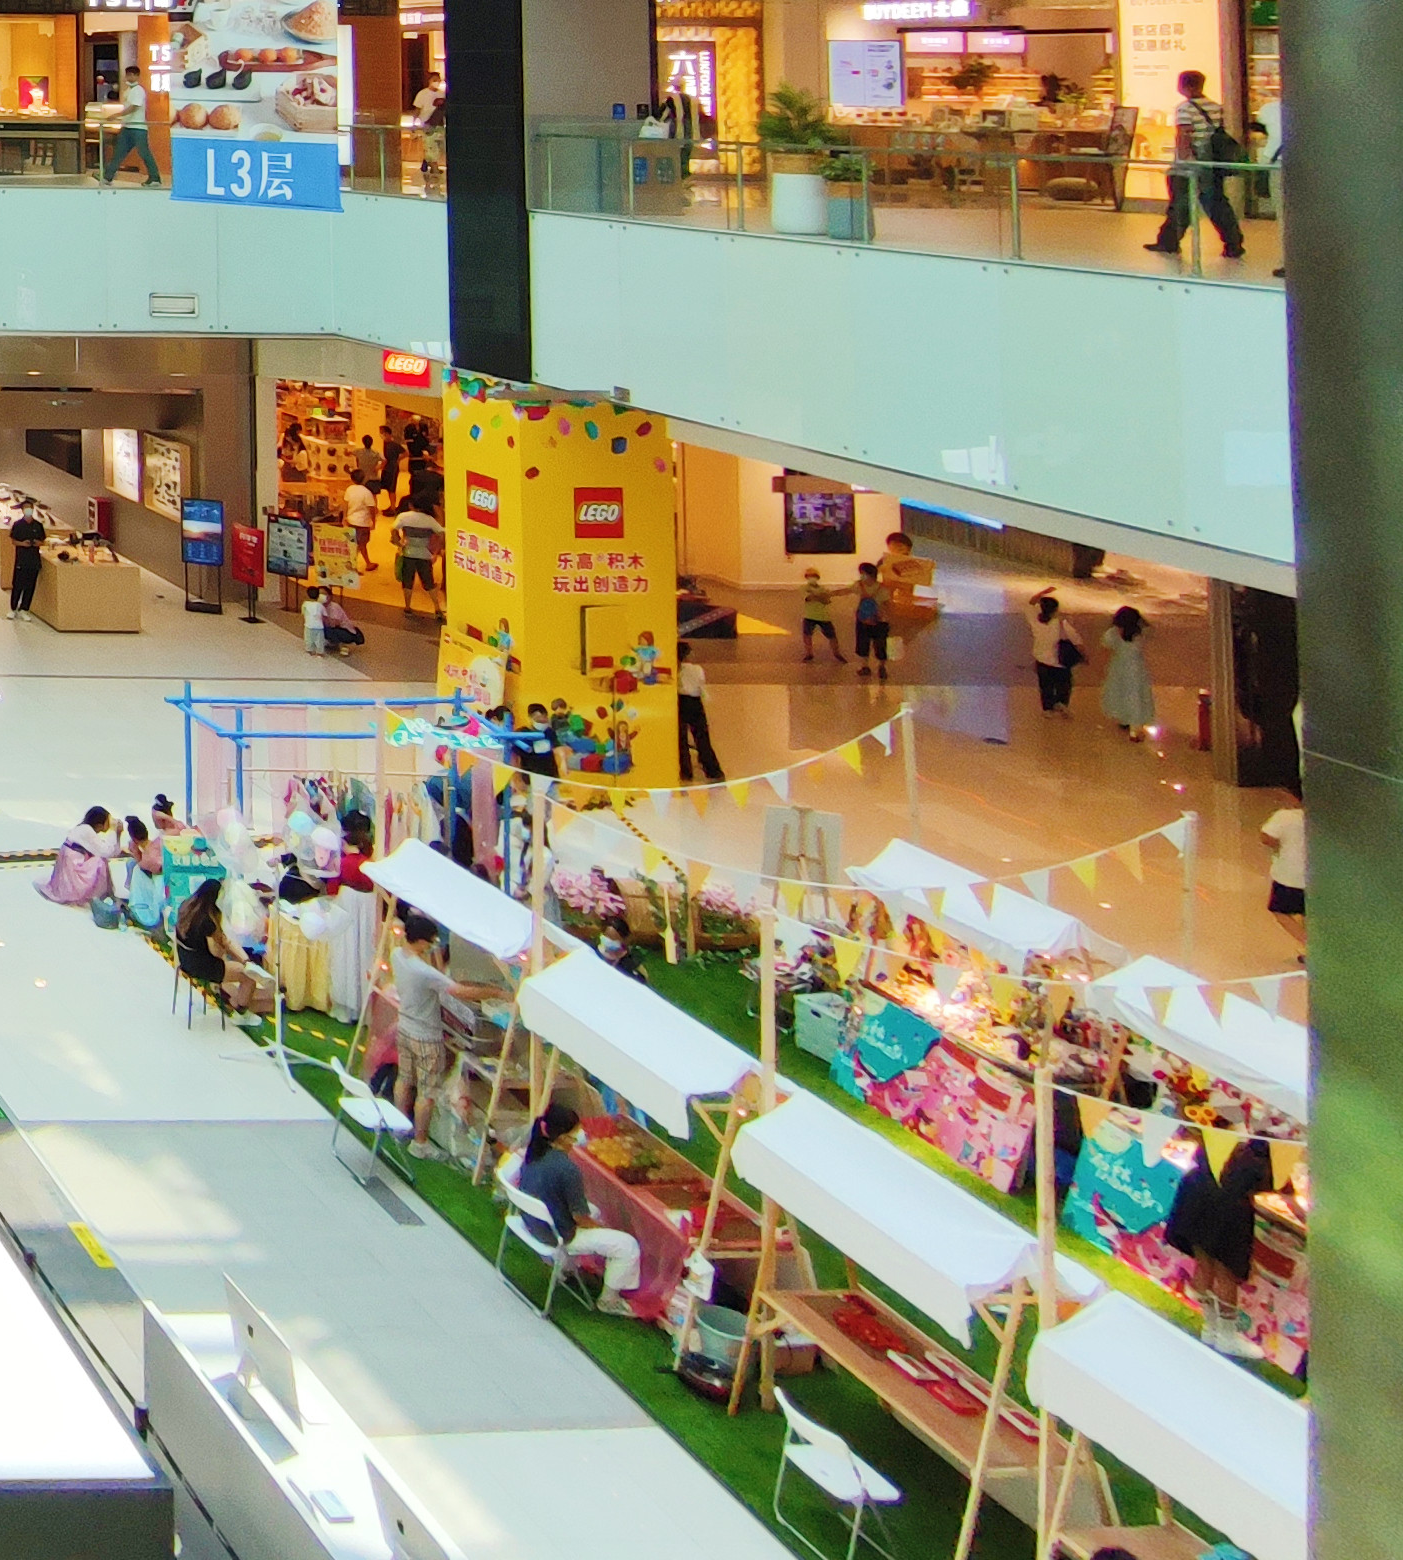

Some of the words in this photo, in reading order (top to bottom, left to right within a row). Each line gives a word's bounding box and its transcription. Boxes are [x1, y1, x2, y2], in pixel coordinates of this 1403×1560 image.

[206, 148, 293, 200] L3层
[386, 356, 426, 374] LEGO
[470, 489, 498, 511] LEGO
[578, 503, 620, 522] LEGO
[454, 550, 517, 589] 玩出创造力
[553, 575, 649, 593] 玩出创造力
